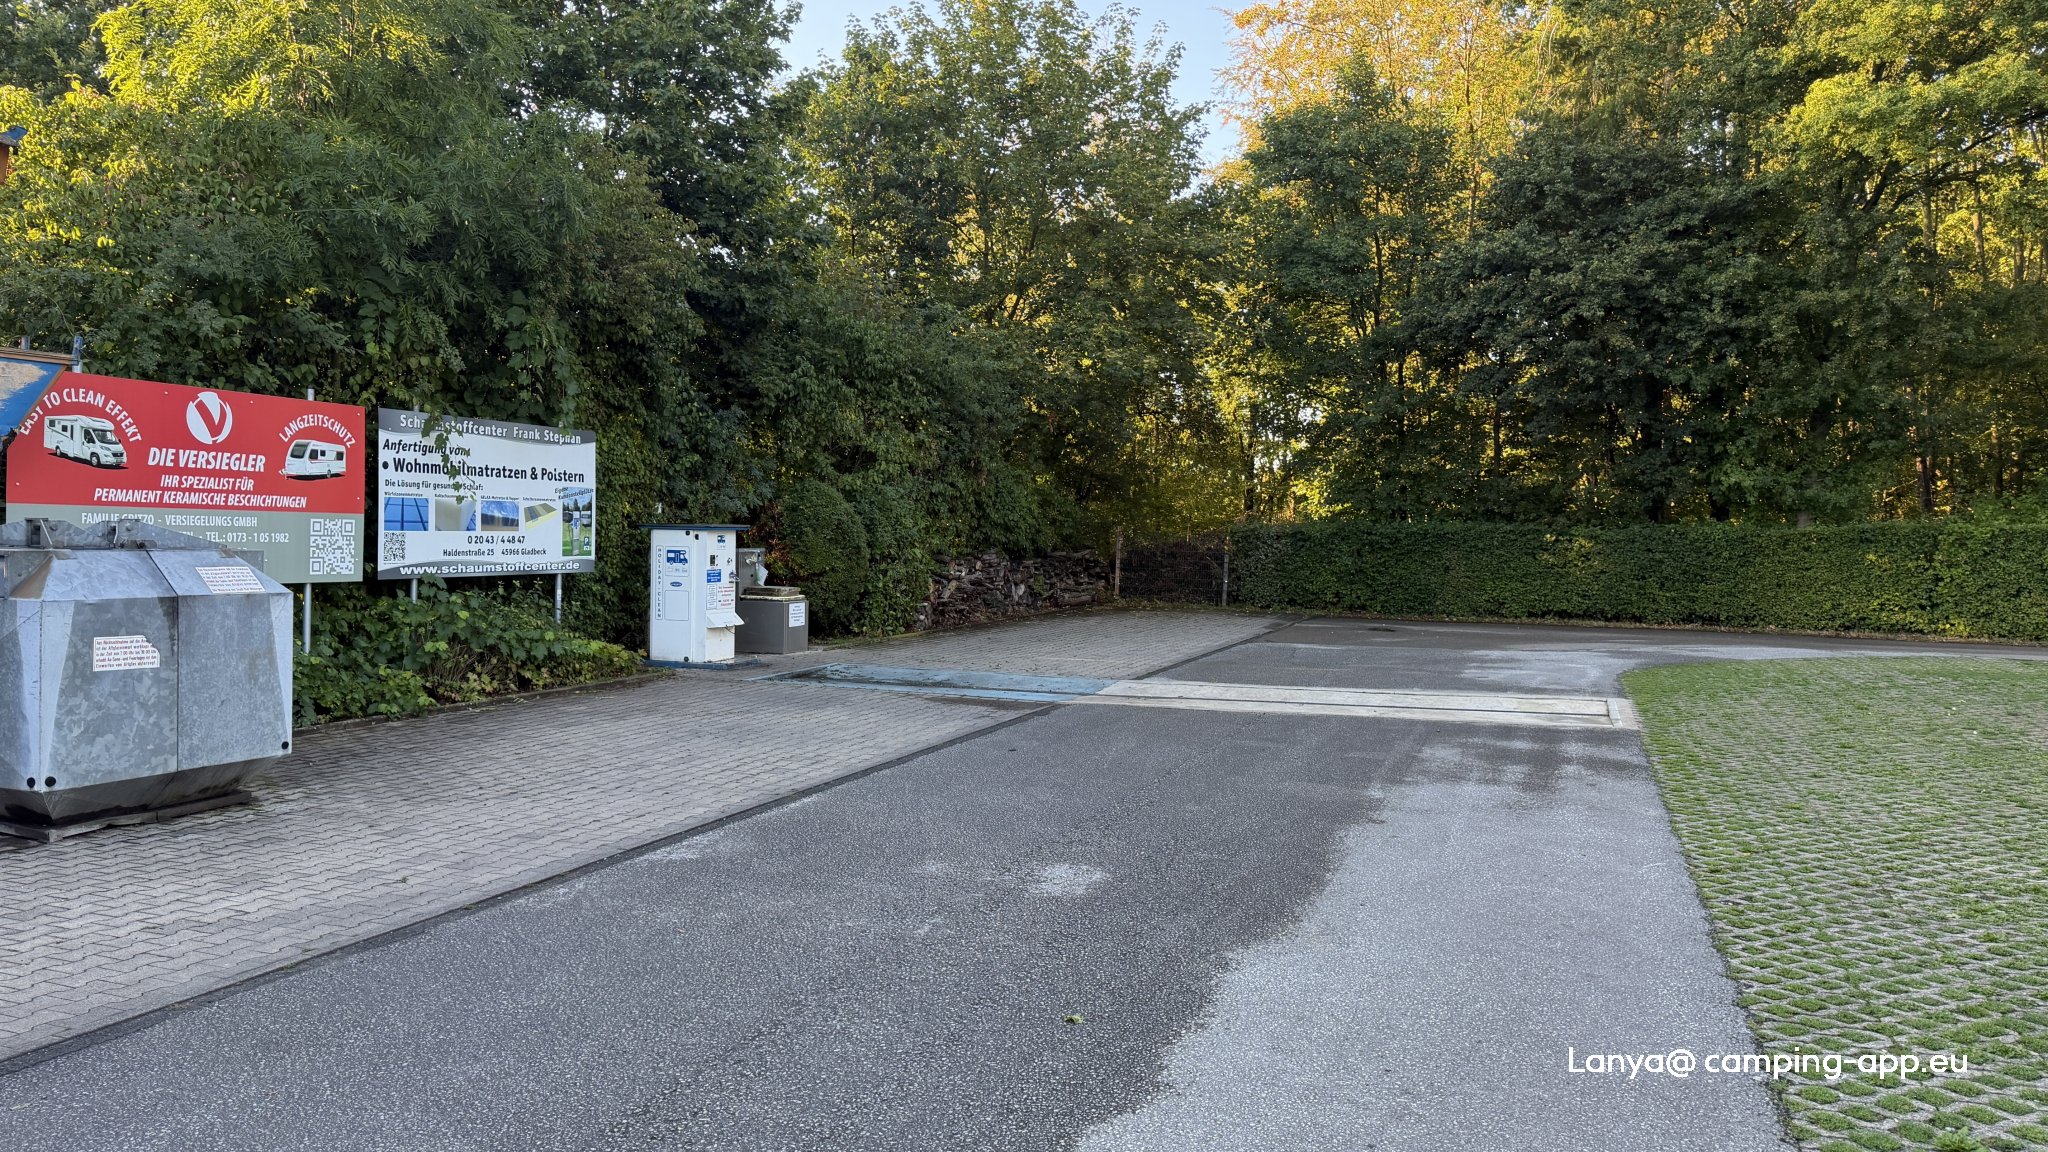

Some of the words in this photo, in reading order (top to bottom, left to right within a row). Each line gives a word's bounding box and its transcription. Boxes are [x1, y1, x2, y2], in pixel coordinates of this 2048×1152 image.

[43, 391, 60, 408] TO
[62, 388, 105, 408] CLEAN
[105, 400, 142, 442] EFFEKT
[279, 413, 356, 448] LANGZEITSCHUTZ
[514, 426, 540, 440] Frank
[148, 447, 176, 467] DIE
[178, 448, 266, 472] VERSIEGLER
[530, 466, 538, 480] &
[160, 474, 179, 488] IHR
[181, 476, 234, 490] SPEZIALIST
[235, 476, 254, 491] FÜR
[385, 479, 396, 487] Die
[398, 480, 420, 490] Lösung
[422, 481, 432, 489] für
[94, 487, 162, 504] PERMANENT
[163, 490, 226, 506] KERAMISCHE
[228, 493, 307, 508] BESCHICHTUNGEN
[165, 515, 232, 526] VERSIEGELUNGS
[233, 516, 258, 527] GMBH
[206, 532, 226, 542] TEL.:
[227, 532, 248, 542] 0173
[260, 533, 269, 542] 05
[271, 533, 290, 542] 1982
[474, 536, 484, 544] 20
[485, 536, 494, 544] 43
[506, 536, 516, 544] 48
[517, 536, 526, 544] 47
[443, 548, 486, 558] Haldenstraße
[486, 548, 494, 556] 25
[501, 548, 520, 556] 45966
[520, 548, 546, 556] Gladbeck
[400, 561, 580, 575] www.schaumstoffcenter.de
